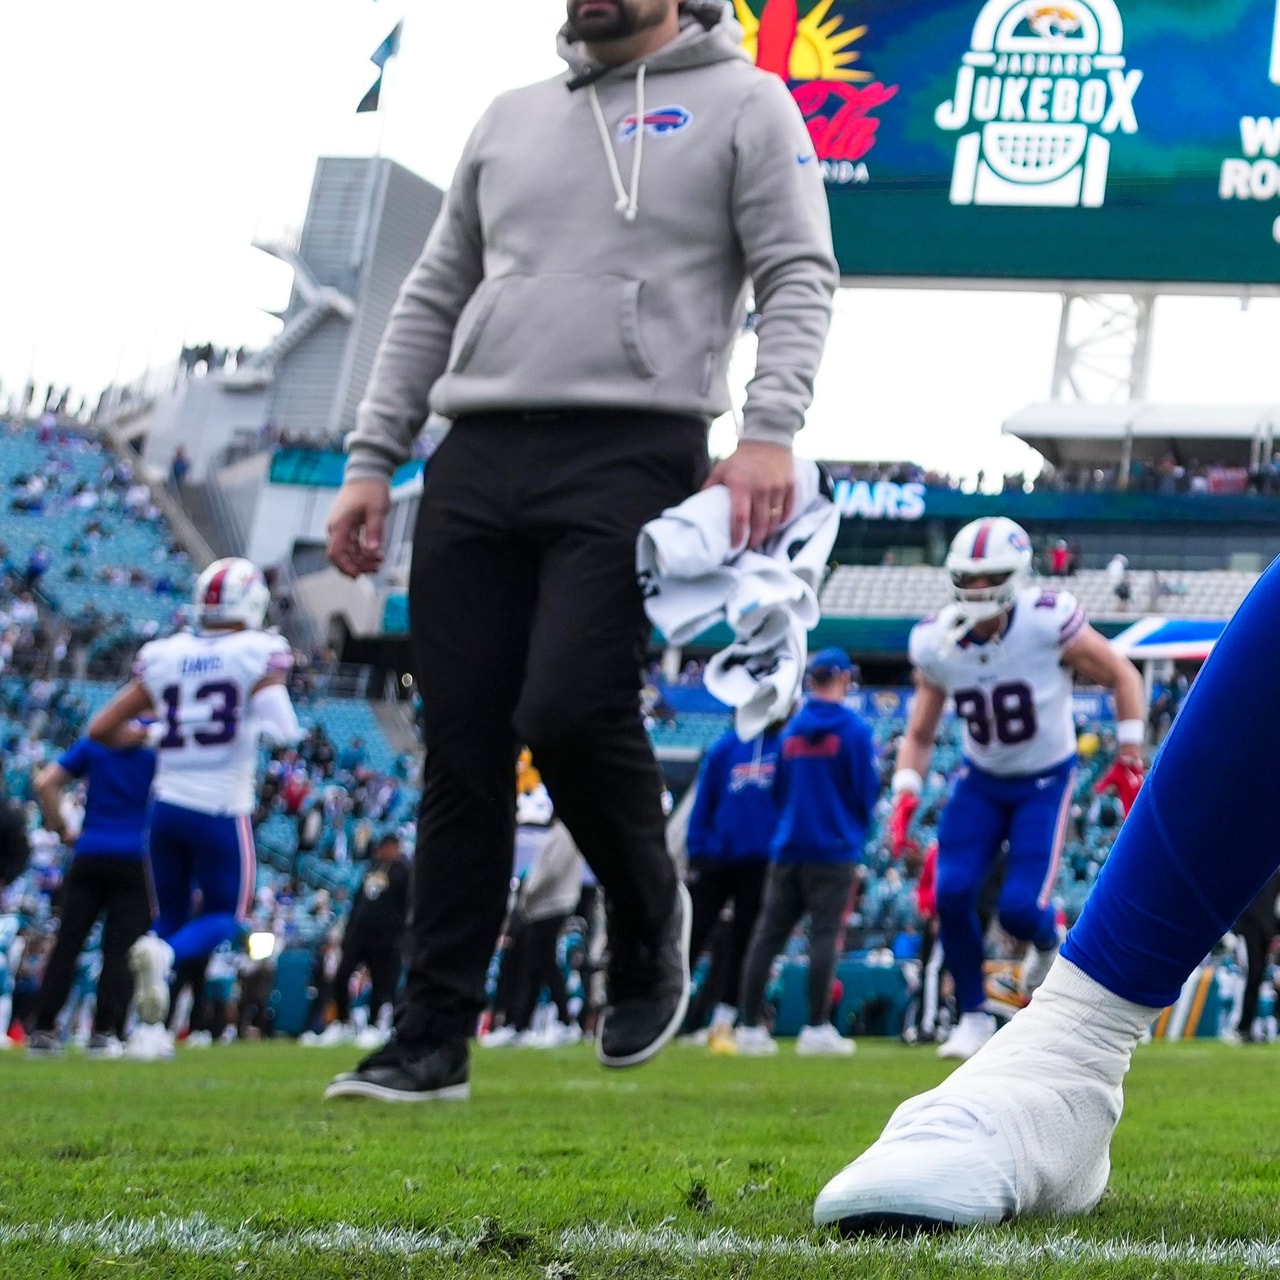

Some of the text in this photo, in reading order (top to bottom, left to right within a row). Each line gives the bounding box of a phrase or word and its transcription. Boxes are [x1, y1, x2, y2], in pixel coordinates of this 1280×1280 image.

[995, 54, 1092, 76] JAGUARS
[934, 65, 1143, 134] JUKEBOX
[159, 683, 239, 748] 13
